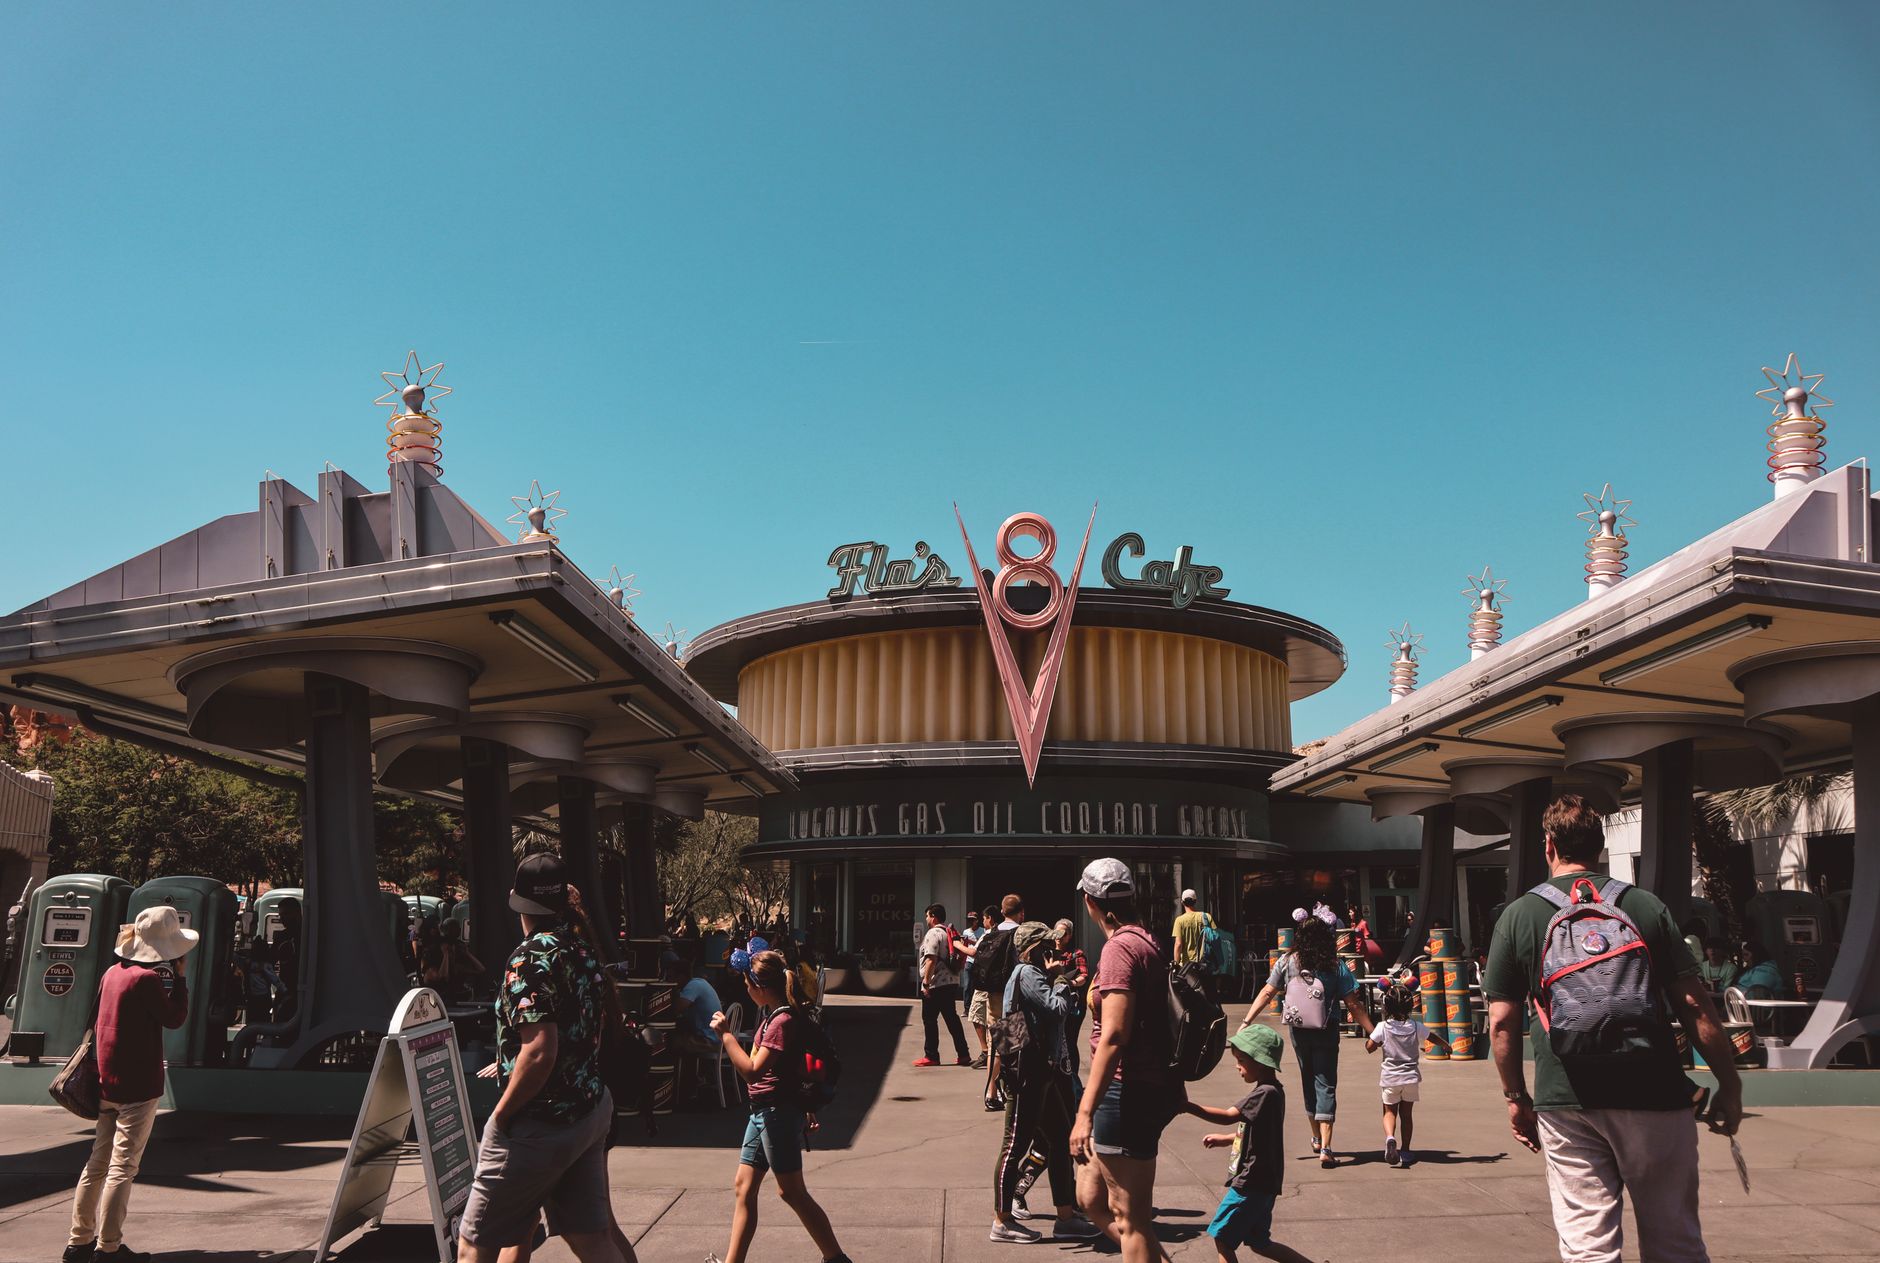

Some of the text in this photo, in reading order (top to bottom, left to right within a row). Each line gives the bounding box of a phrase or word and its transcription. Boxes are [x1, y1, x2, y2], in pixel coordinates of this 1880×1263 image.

[1101, 532, 1231, 609] Cafe
[898, 802, 946, 835] GAS
[973, 801, 1016, 834] OIL
[1041, 802, 1158, 836] COOLANT
[1178, 804, 1249, 839] GREASE
[871, 893, 896, 905] DIP
[858, 910, 912, 921] STICKS
[52, 952, 72, 960] ETHYL
